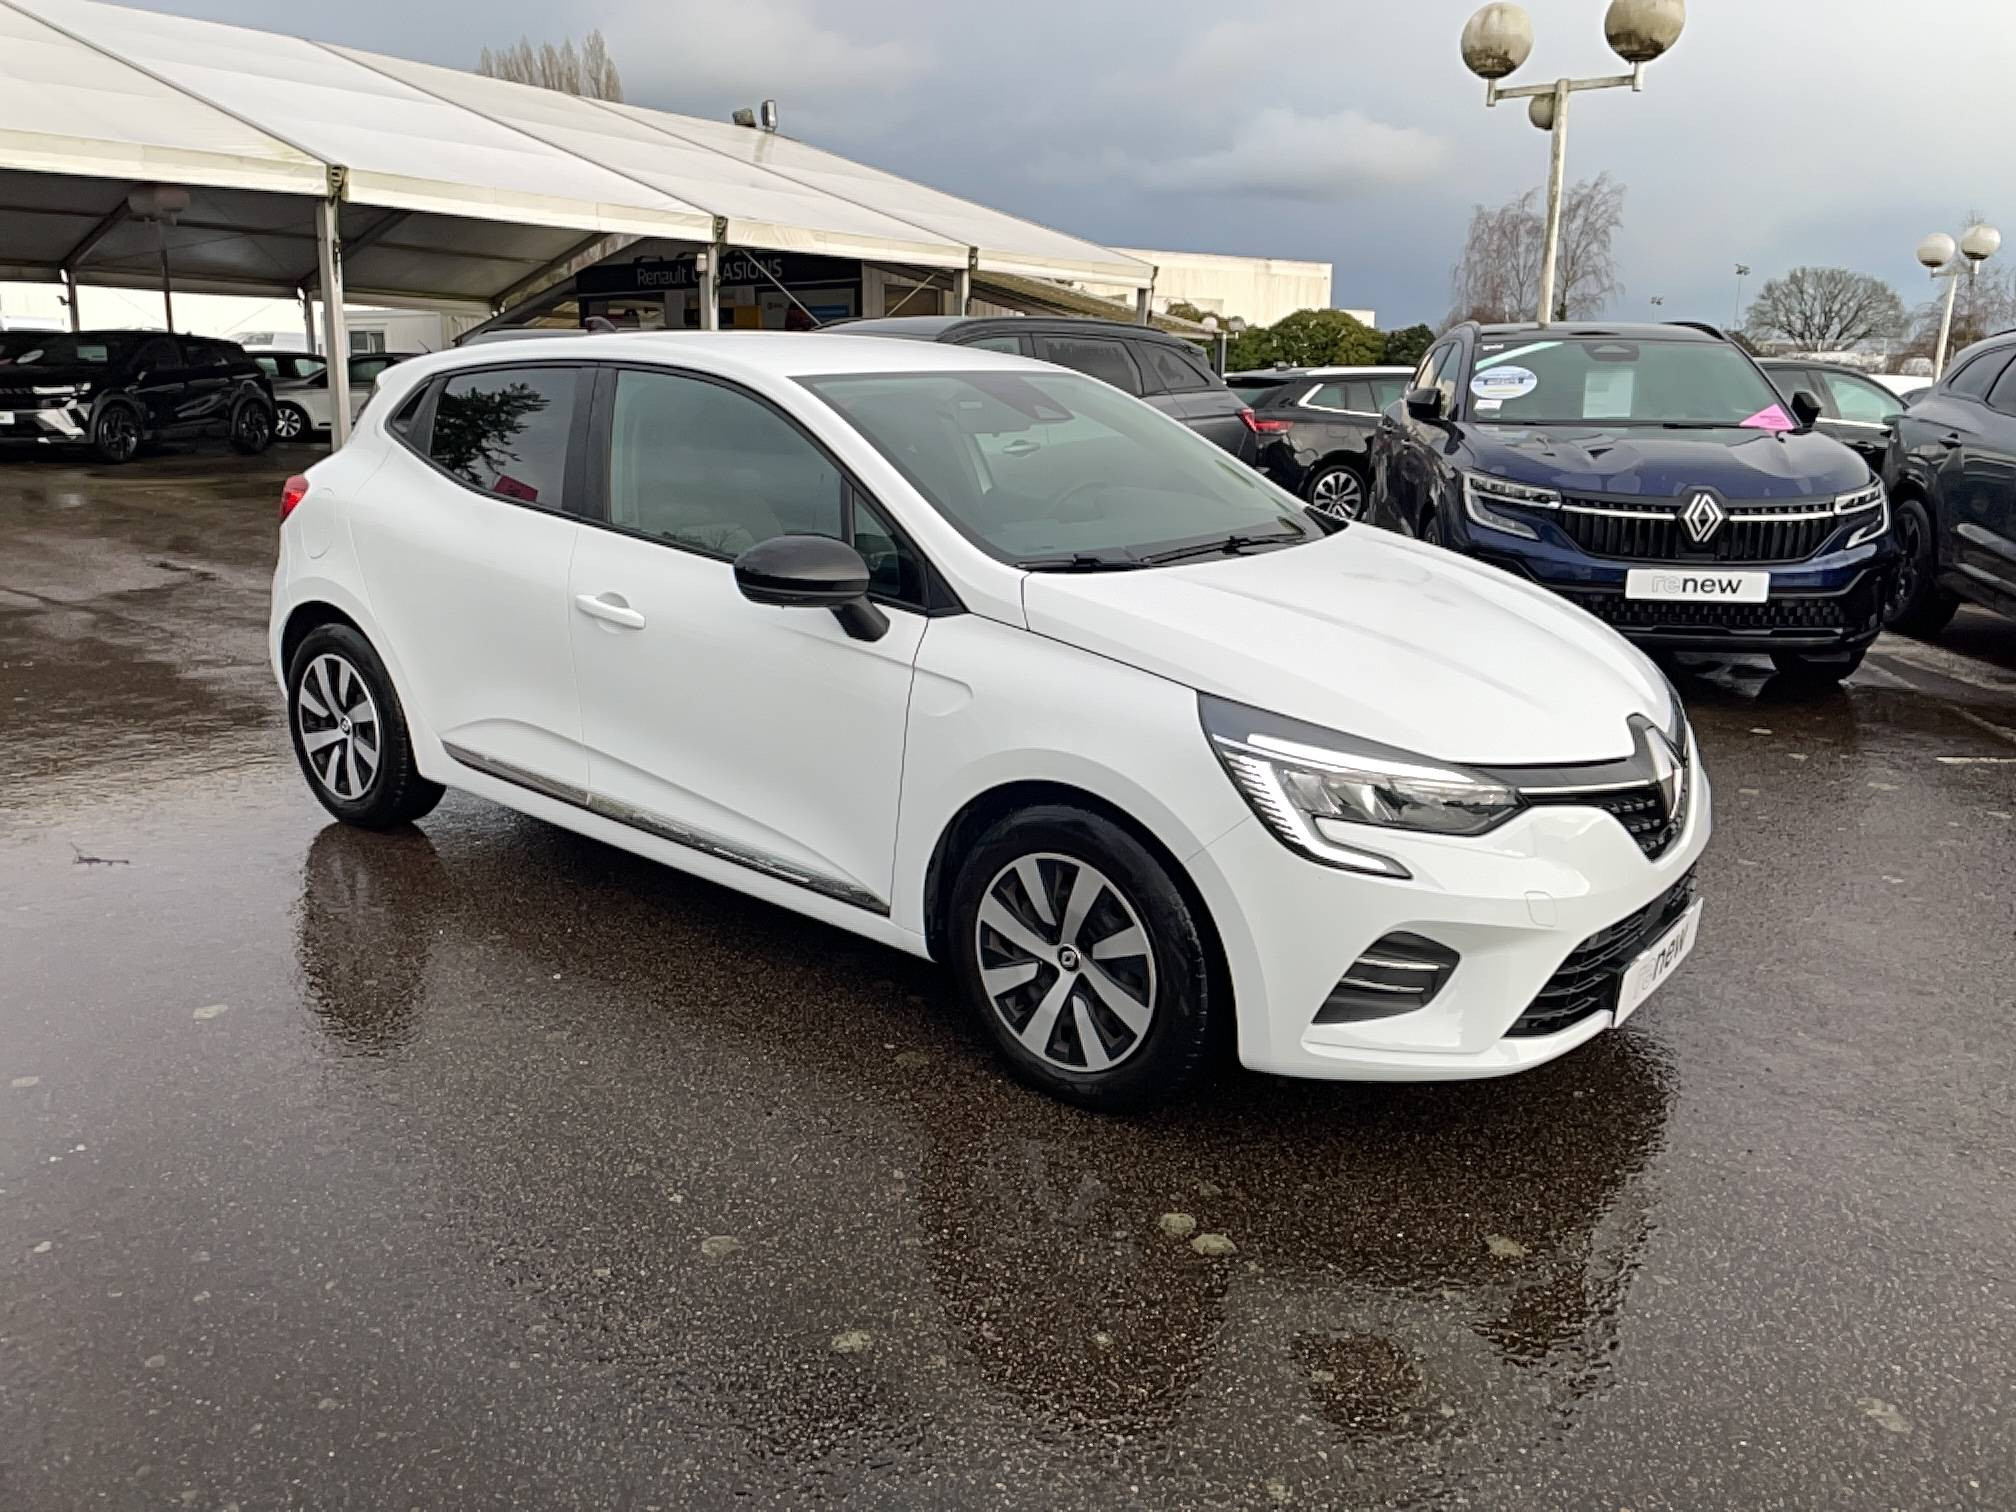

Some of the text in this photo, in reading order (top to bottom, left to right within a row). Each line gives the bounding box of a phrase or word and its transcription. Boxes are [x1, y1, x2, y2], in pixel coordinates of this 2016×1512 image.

[636, 258, 782, 287] Renault ASIONS
[1651, 575, 1742, 594] renew
